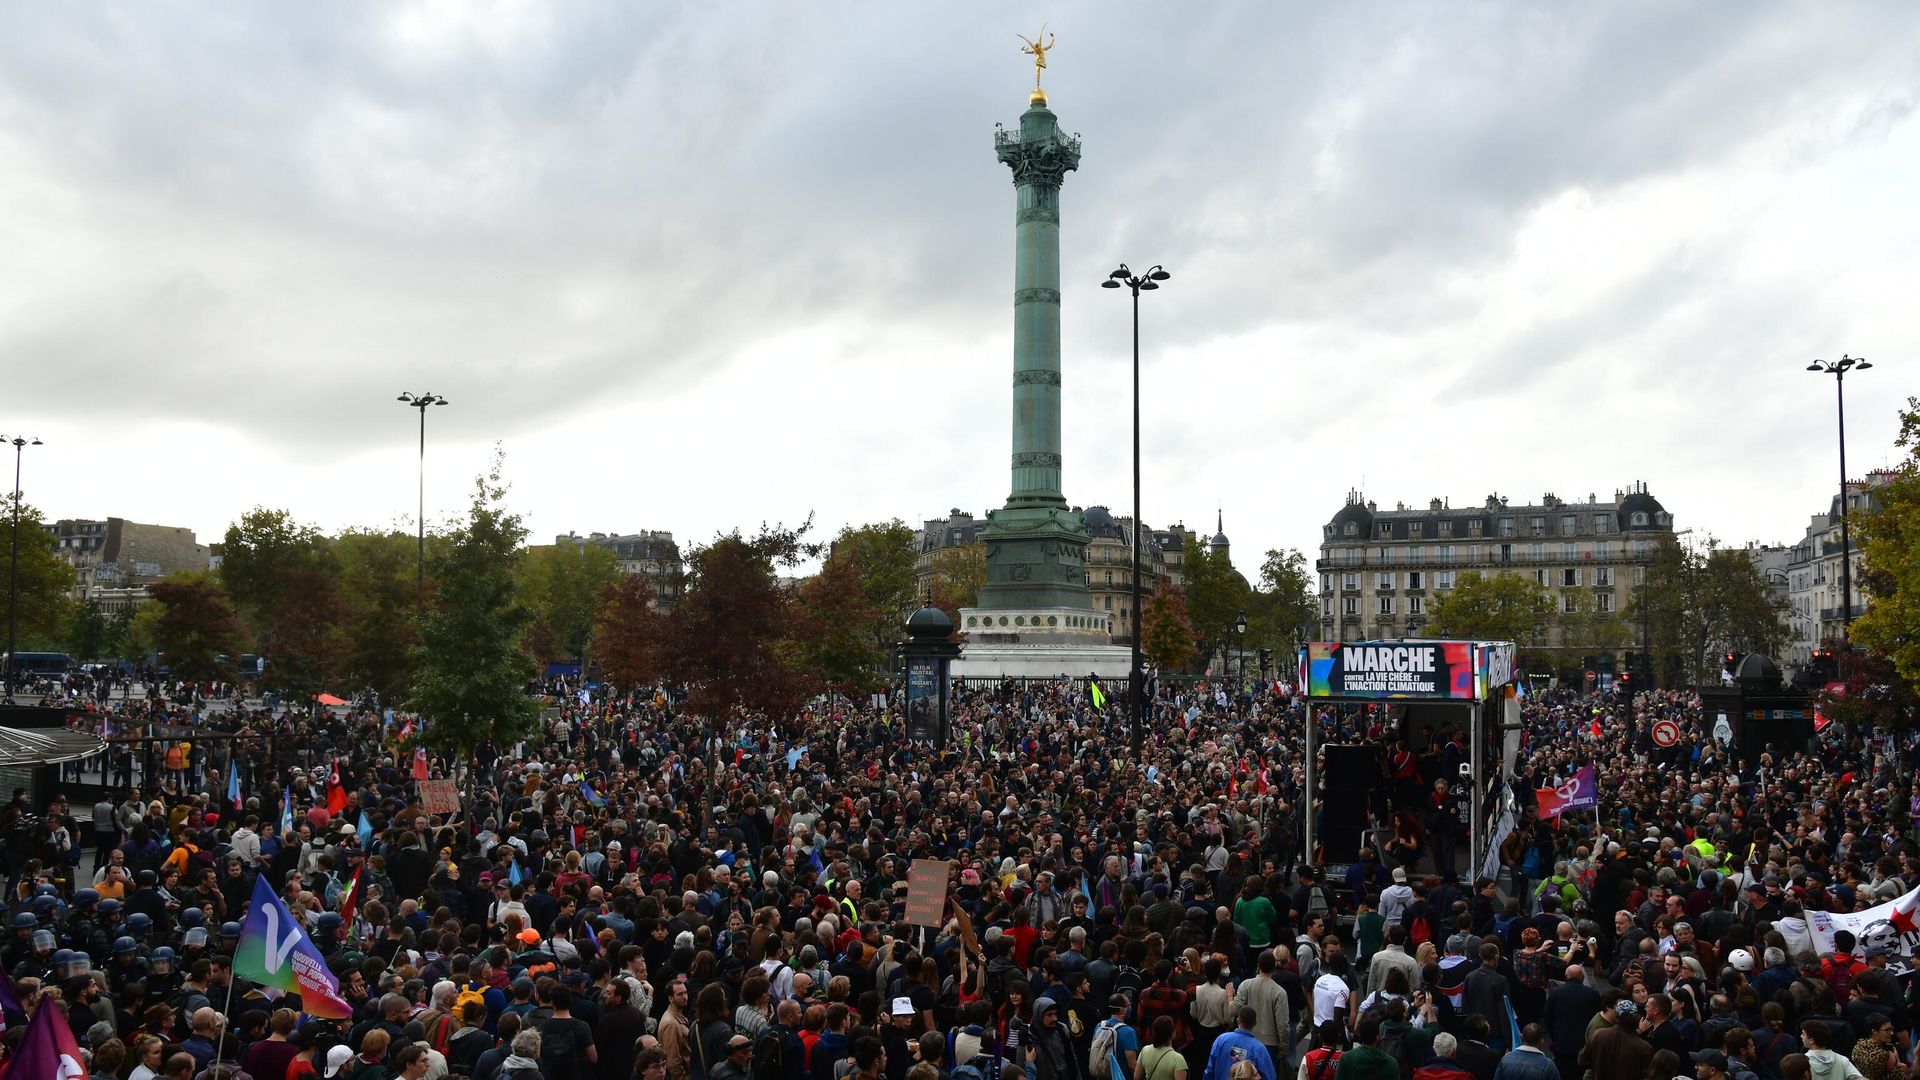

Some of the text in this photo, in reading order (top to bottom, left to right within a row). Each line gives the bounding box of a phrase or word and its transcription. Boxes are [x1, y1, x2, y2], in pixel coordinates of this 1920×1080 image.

[1343, 647, 1435, 672] MARCHE
[1366, 672, 1376, 681] LA
[1376, 672, 1388, 681] VIE
[1389, 671, 1413, 681] CHÈRE
[1388, 682, 1435, 692] CLIMATIQUE
[293, 950, 322, 972] NOUVELLE
